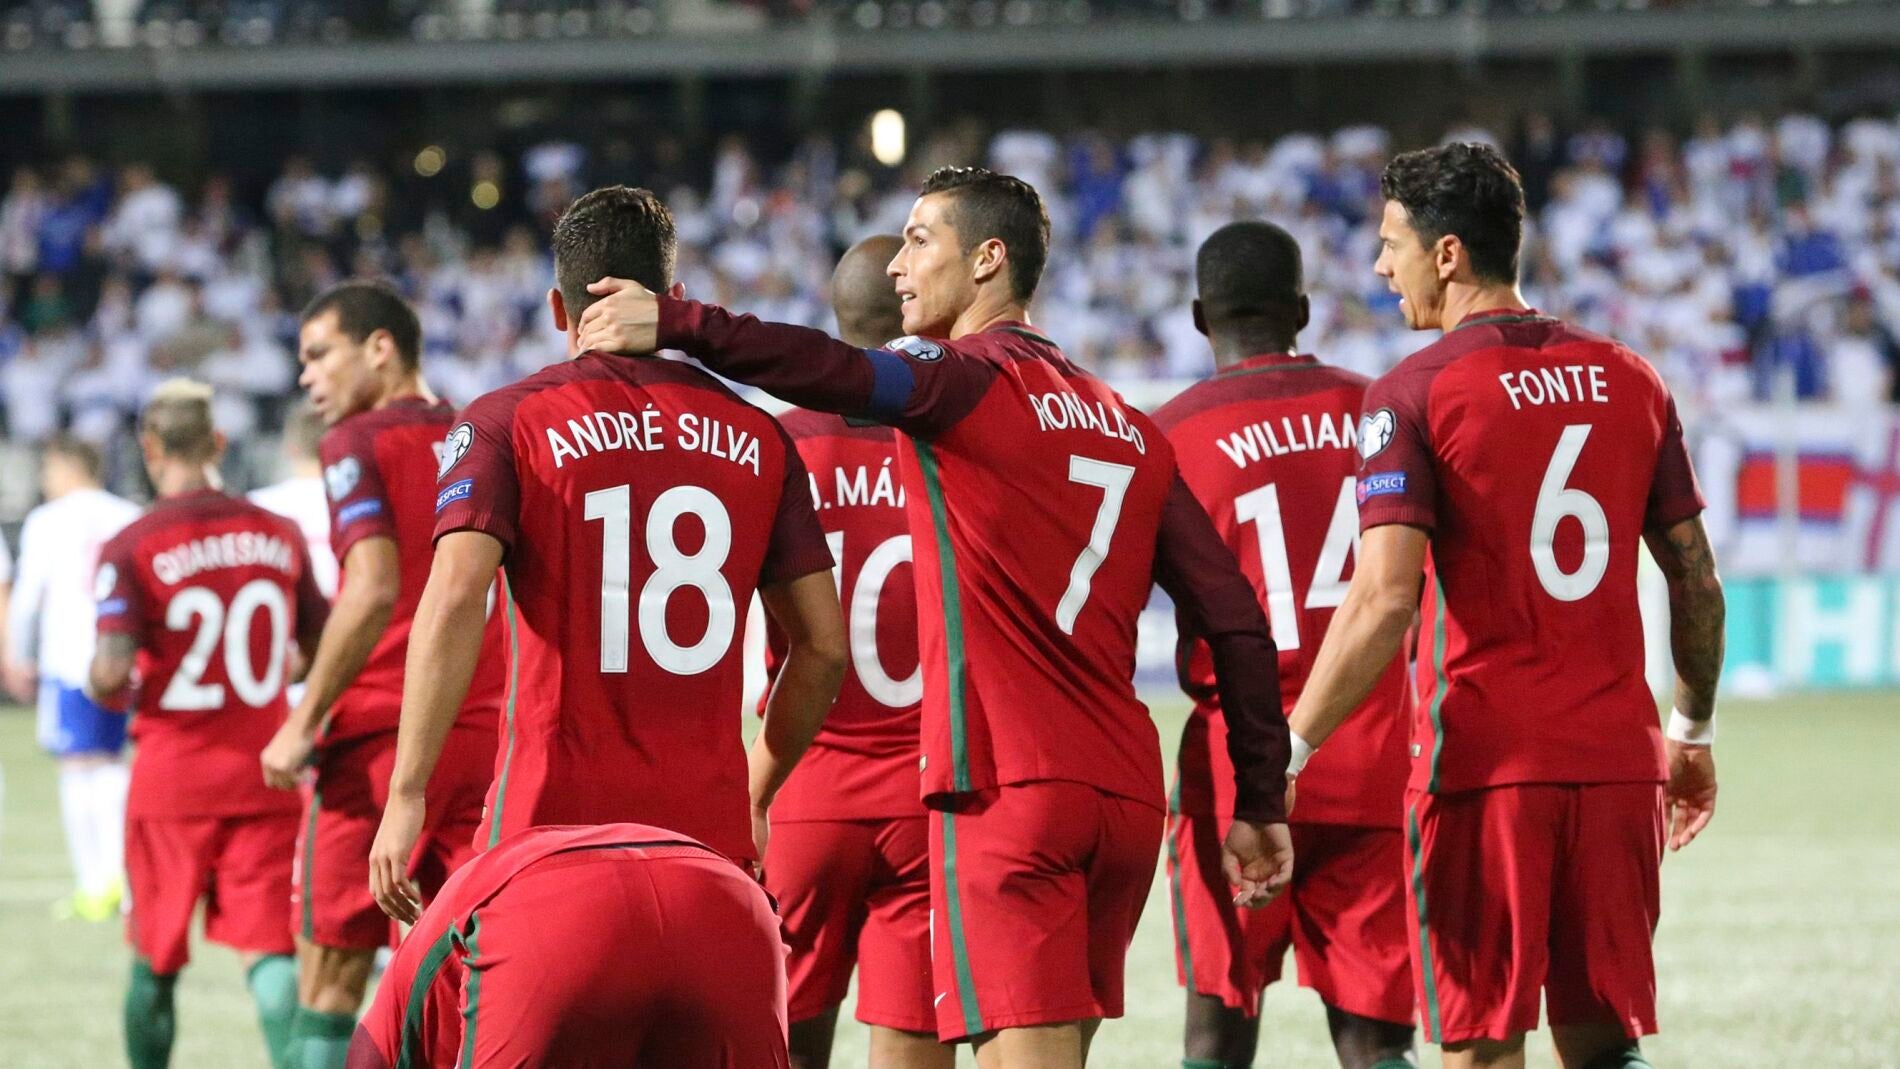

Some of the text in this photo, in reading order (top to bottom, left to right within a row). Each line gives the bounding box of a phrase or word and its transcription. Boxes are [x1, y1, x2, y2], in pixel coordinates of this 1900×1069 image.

[546, 403, 760, 477] ANDRÉ SILVA
[1029, 391, 1146, 455] RONALDO
[1499, 365, 1609, 410] FONTE
[152, 531, 293, 586] QUARESMA
[1056, 454, 1136, 636] 7
[1234, 476, 1361, 651] 14
[1530, 424, 1610, 601] 6
[159, 578, 288, 711] 20
[584, 484, 736, 676] 18
